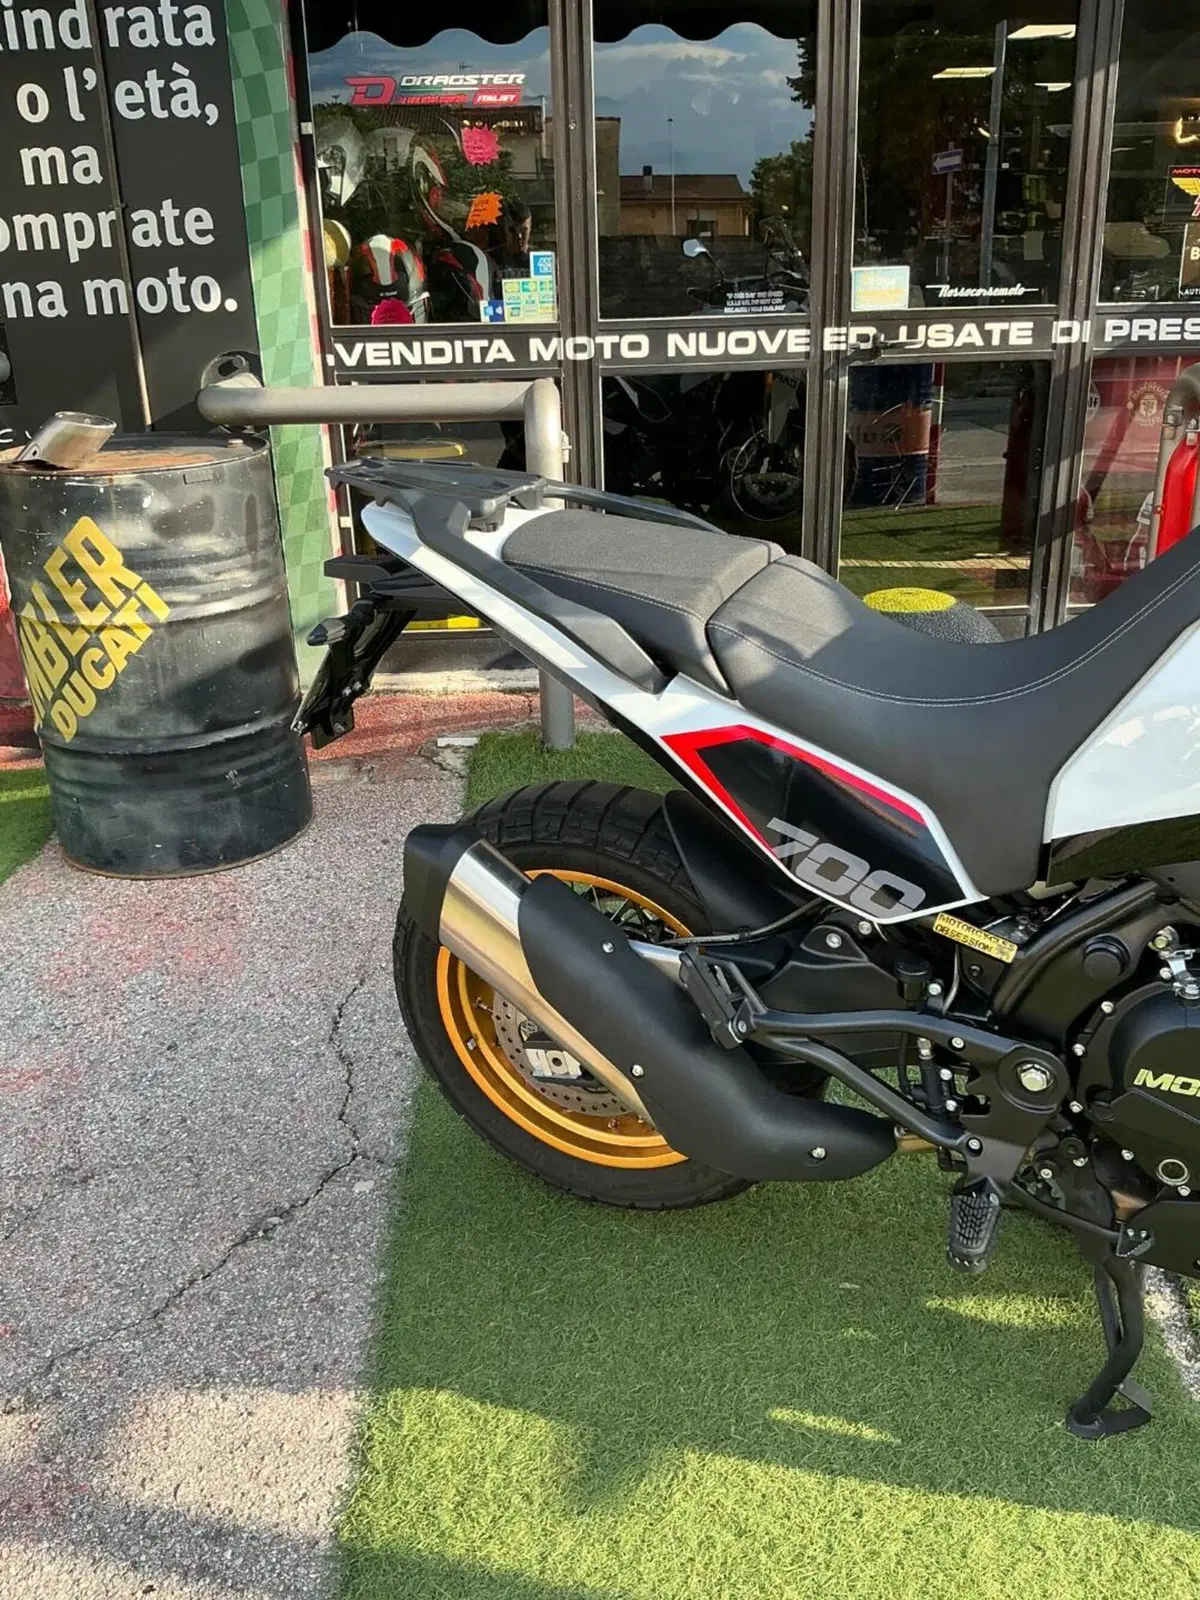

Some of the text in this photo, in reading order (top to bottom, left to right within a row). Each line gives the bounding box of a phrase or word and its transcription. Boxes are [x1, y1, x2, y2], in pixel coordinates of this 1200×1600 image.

[400, 74, 526, 86] DRAGSTER
[16, 82, 50, 123] o
[20, 143, 103, 186] ma
[1190, 246, 1200, 260] B
[530, 334, 649, 361] MOTO
[667, 328, 811, 357] NUOVE
[823, 326, 878, 351] ED
[899, 321, 1032, 349] USATE
[1051, 320, 1091, 343] DI
[51, 583, 171, 743] DUCATI
[766, 817, 926, 919] 700
[935, 923, 994, 952] OBSESSION
[939, 914, 1015, 952] MOTORCYCLES
[1133, 1068, 1200, 1098] MO
